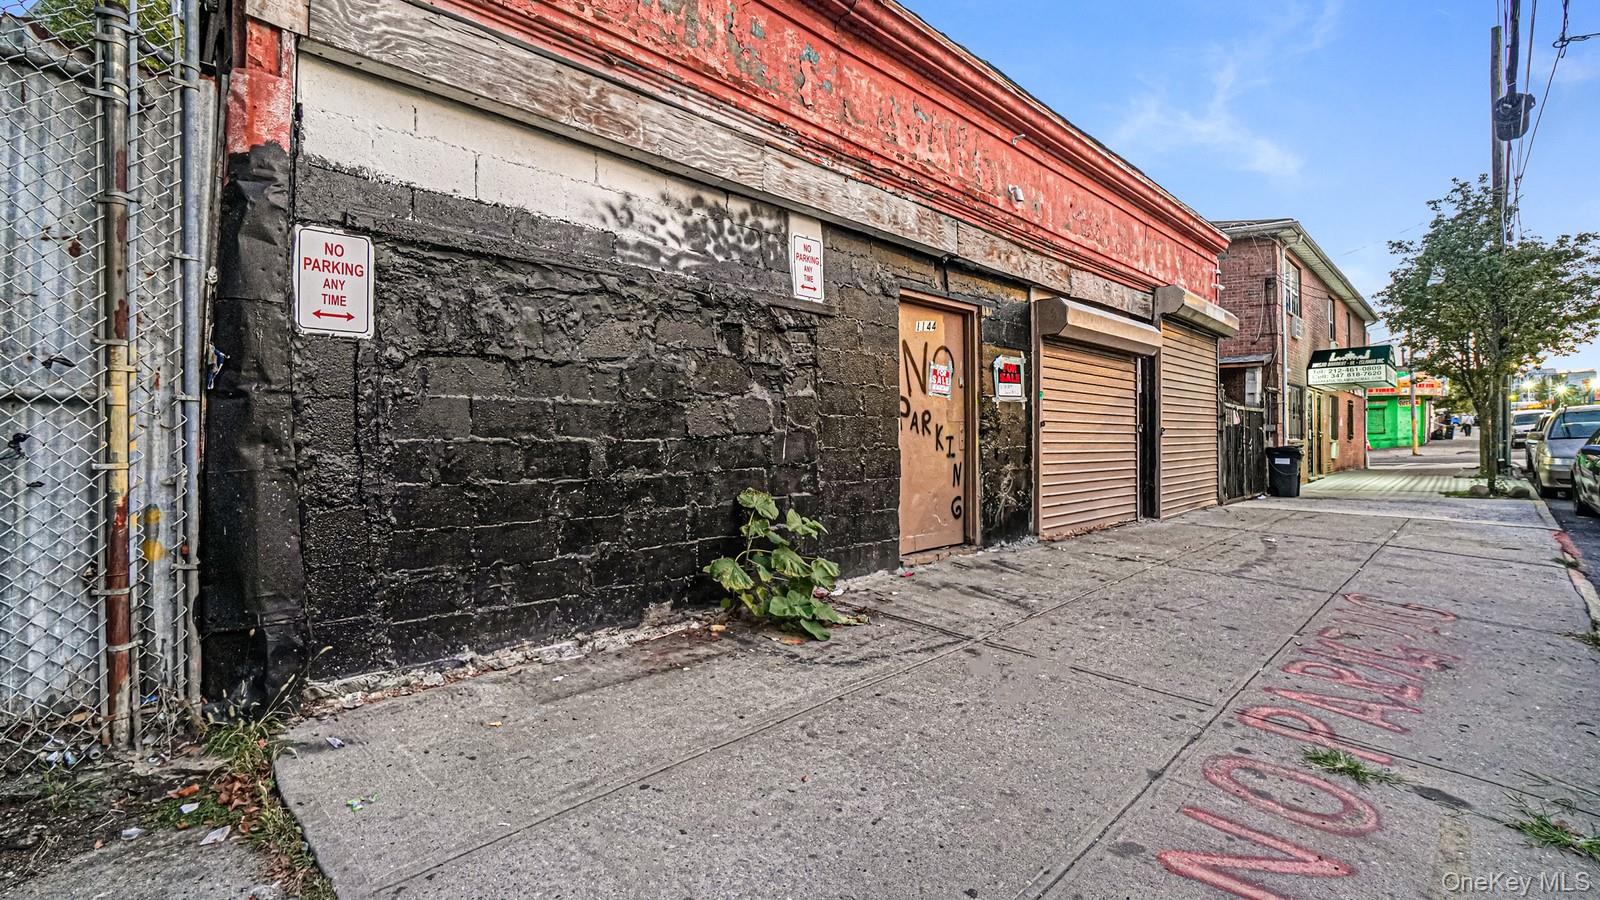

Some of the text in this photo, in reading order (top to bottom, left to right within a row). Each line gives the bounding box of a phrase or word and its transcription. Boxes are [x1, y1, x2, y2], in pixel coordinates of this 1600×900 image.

[324, 242, 344, 257] NO
[804, 244, 812, 254] NO
[796, 254, 820, 266] PARKING
[303, 257, 364, 277] PARKING
[323, 278, 346, 291] ANY
[804, 274, 814, 282] TIME
[321, 293, 347, 307] TIME
[916, 321, 937, 332] 1144
[902, 338, 954, 397] NO
[931, 375, 951, 386] SALE
[899, 396, 963, 520] PARKING
[1157, 754, 1382, 900] NO
